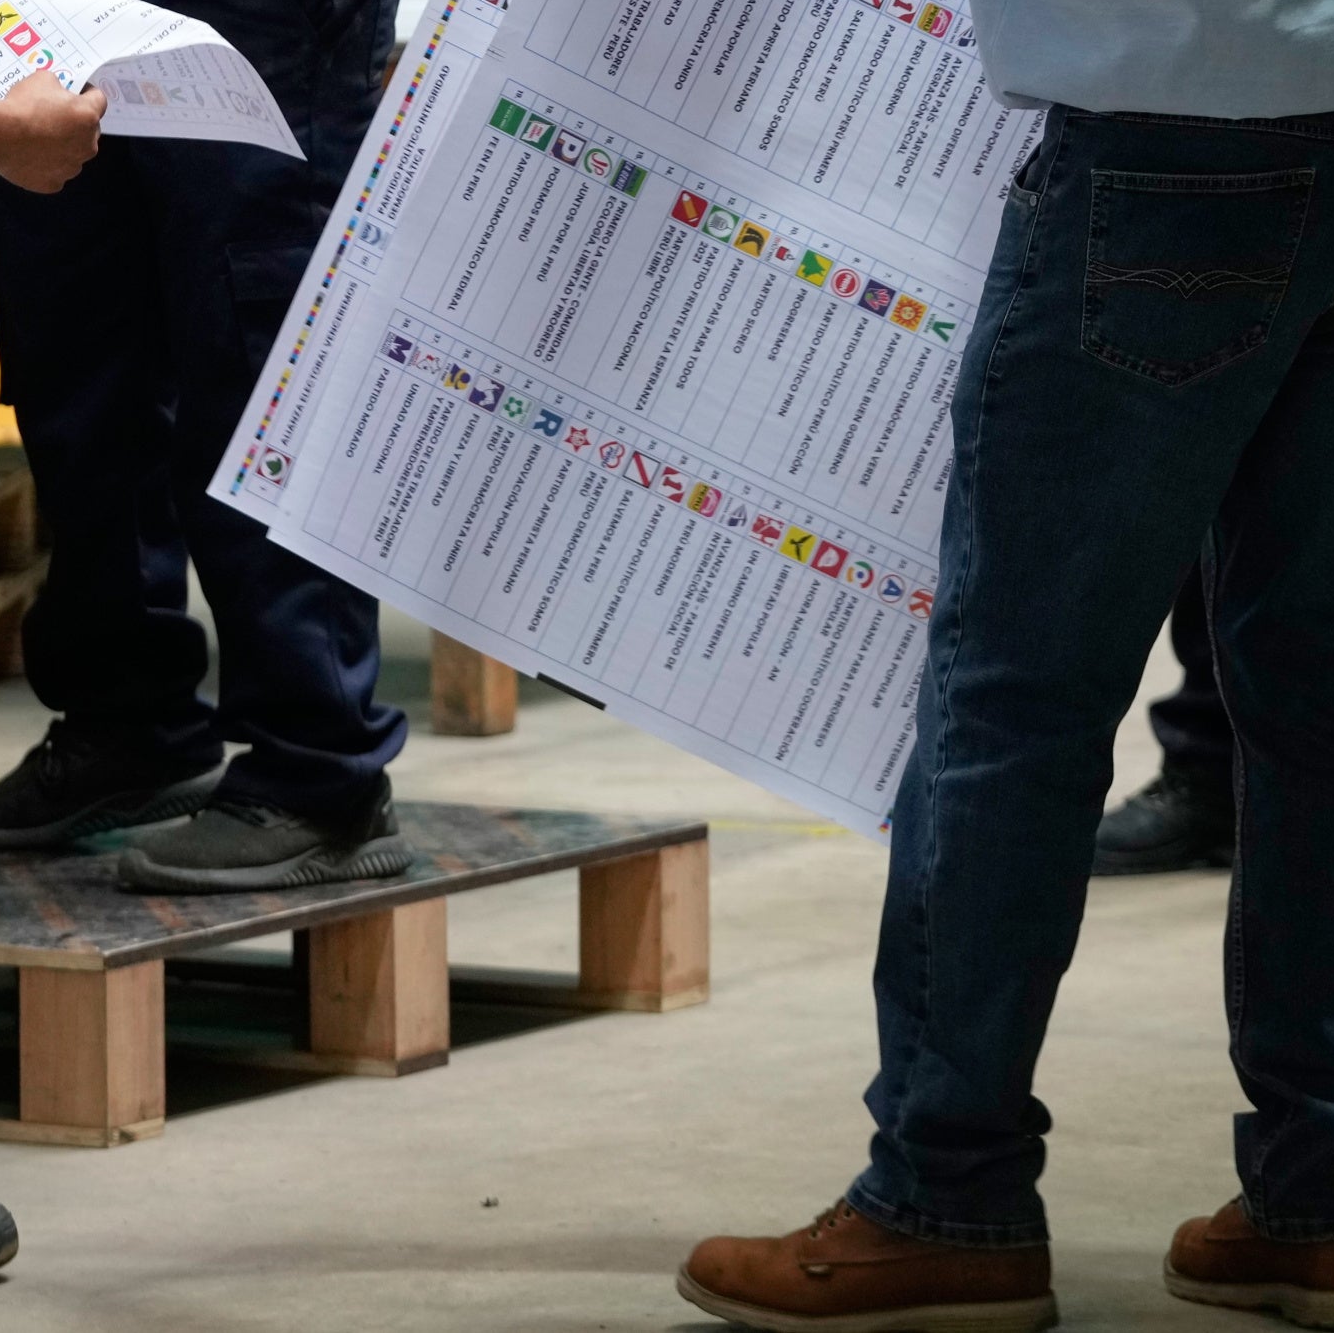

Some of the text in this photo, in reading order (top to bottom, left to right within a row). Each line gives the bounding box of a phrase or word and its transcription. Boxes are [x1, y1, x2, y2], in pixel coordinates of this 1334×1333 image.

[602, 33, 621, 60] PERÚ
[607, 0, 651, 77] TRABAJADORES
[618, 7, 634, 27] PTE
[755, 22, 782, 64] APRISTA
[673, 57, 695, 91] UNIDO
[712, 29, 741, 76] POPULAR
[776, 39, 818, 114] DEMOCRÁTICO
[814, 9, 864, 102] SALVEMOS AL PERÚ
[884, 38, 927, 116] PERÚ MODERNO
[936, 56, 963, 98] AVANZA
[733, 64, 762, 113] PERUANO
[813, 23, 896, 184] PARTIDO POLÍTICO PERÚ PRIMERO
[896, 51, 953, 155] INTEGRACIÓN SOCIAL
[925, 99, 943, 123] PAÍS
[376, 170, 402, 215] PARTIDO
[417, 64, 450, 125] INTEGRIDAD
[758, 113, 782, 151] SOMOS
[901, 130, 928, 175] PARTIDO
[932, 85, 983, 179] CAMINO DIFERENTE
[971, 129, 1000, 176] POPULAR
[462, 135, 500, 201] FE EN EL PERÚ
[894, 174, 907, 188] DE
[997, 184, 1014, 200] AN
[447, 151, 532, 311] PARTIDO DEMOCRATICO FEDERAL
[517, 165, 561, 242] PODEMOS PERÚ
[536, 181, 589, 282] JUNTOS POR EL PERÚ
[601, 200, 628, 245] PRIMERO
[563, 248, 591, 296] LIBERTAD
[578, 258, 599, 291] GENTE
[593, 244, 607, 257] LA
[645, 224, 677, 277] PERÚ LIBRE
[691, 240, 709, 264] 2021
[533, 303, 565, 358] PROGRESO
[612, 229, 688, 371] PARTIDO POLÍTICO NACIONAL
[634, 245, 720, 411] PARTIDO FRENTE DE LA ESPERANZA
[675, 257, 744, 390] PARTIDO PAÍS PARA TODOS
[732, 272, 777, 354] PARTIDO SICREO
[767, 287, 808, 361] PROGRESEMOS
[931, 321, 956, 342] V
[280, 281, 358, 447] ALIANZA ELECTORAL VENCEREMOS
[345, 367, 390, 458] PARTIDO MORADO
[373, 382, 420, 474] UNIDAD NACIONAL
[532, 408, 563, 436] R
[481, 443, 541, 557] RENOVACIÓN POPULAR
[814, 608, 885, 748] ALIANZA PARA EL PROGRESO
[871, 623, 917, 709] FUERZA POPULAR
